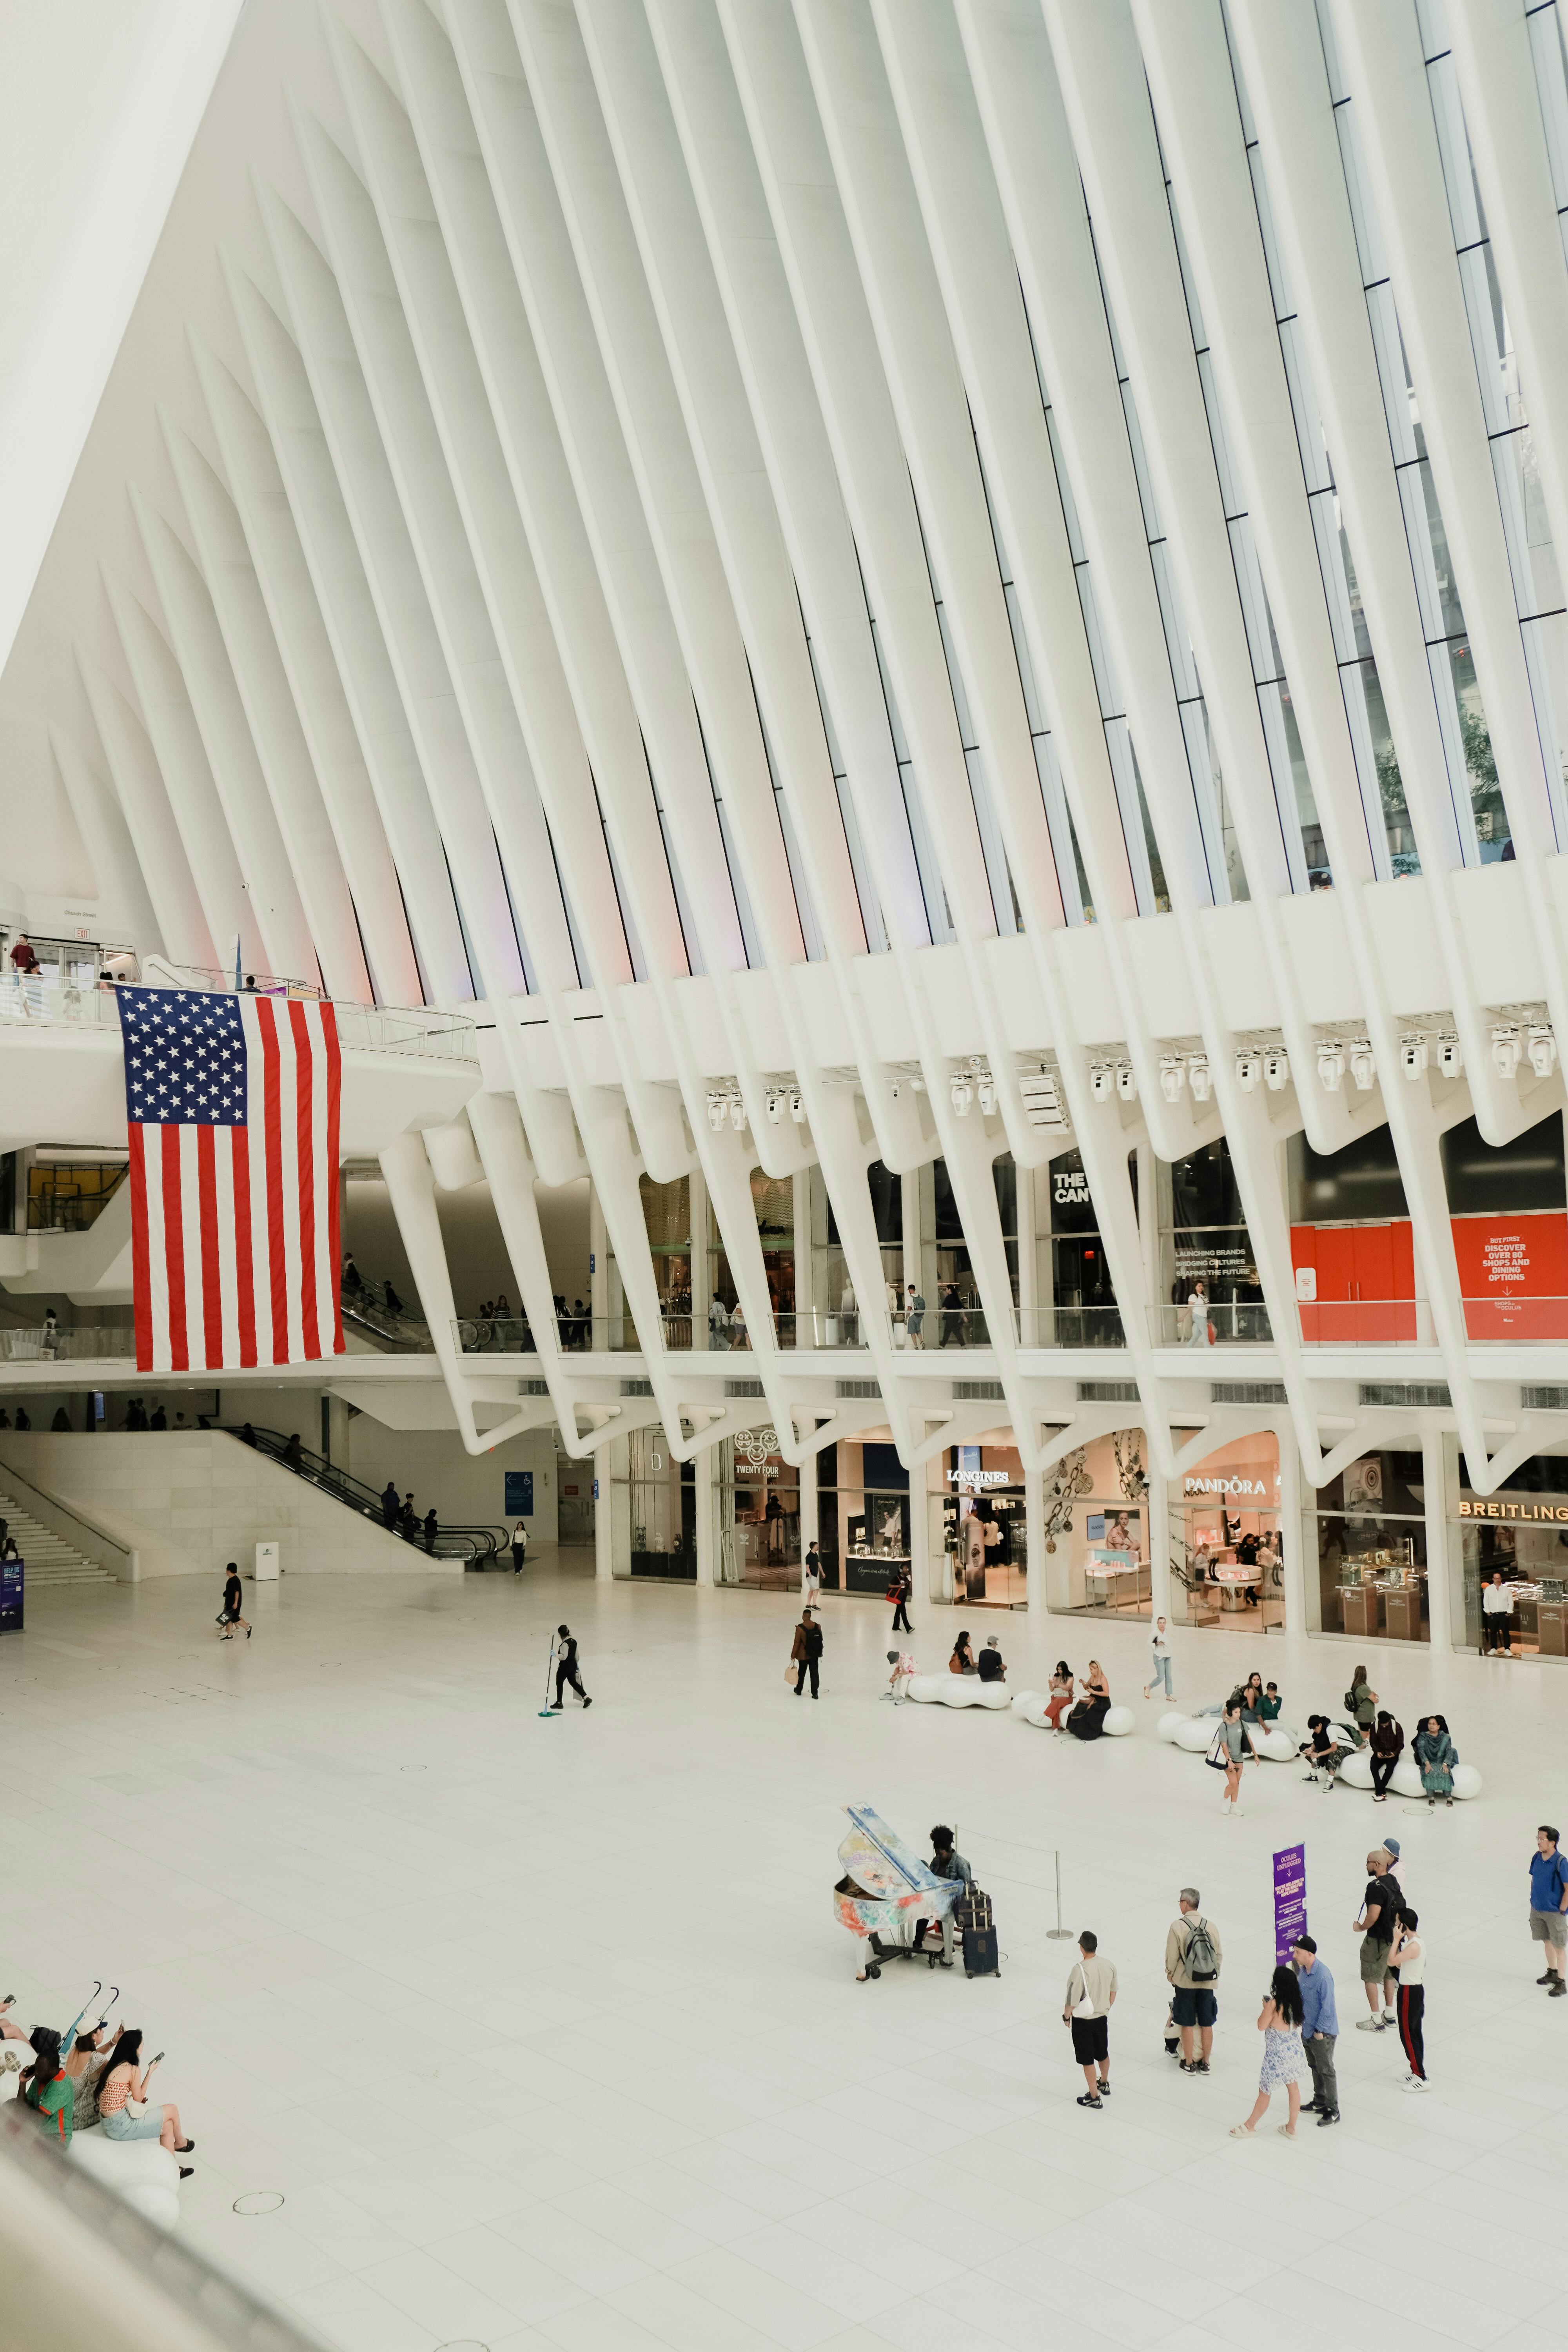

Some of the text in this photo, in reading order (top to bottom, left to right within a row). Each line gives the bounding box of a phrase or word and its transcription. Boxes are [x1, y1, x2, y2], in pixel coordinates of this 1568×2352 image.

[77, 929, 88, 938] EXIT
[1054, 1172, 1085, 1188] THE
[1054, 1188, 1089, 1203] CAN
[1485, 1244, 1526, 1252] DISCOVER
[736, 1465, 761, 1474] TWENTY
[947, 1470, 1009, 1483] LONGINES
[1185, 1476, 1266, 1495] PANDORA
[1459, 1501, 1568, 1521] BREITLING
[1277, 1858, 1301, 1871] UNPLUGGED
[1281, 1853, 1297, 1863] OCULUS
